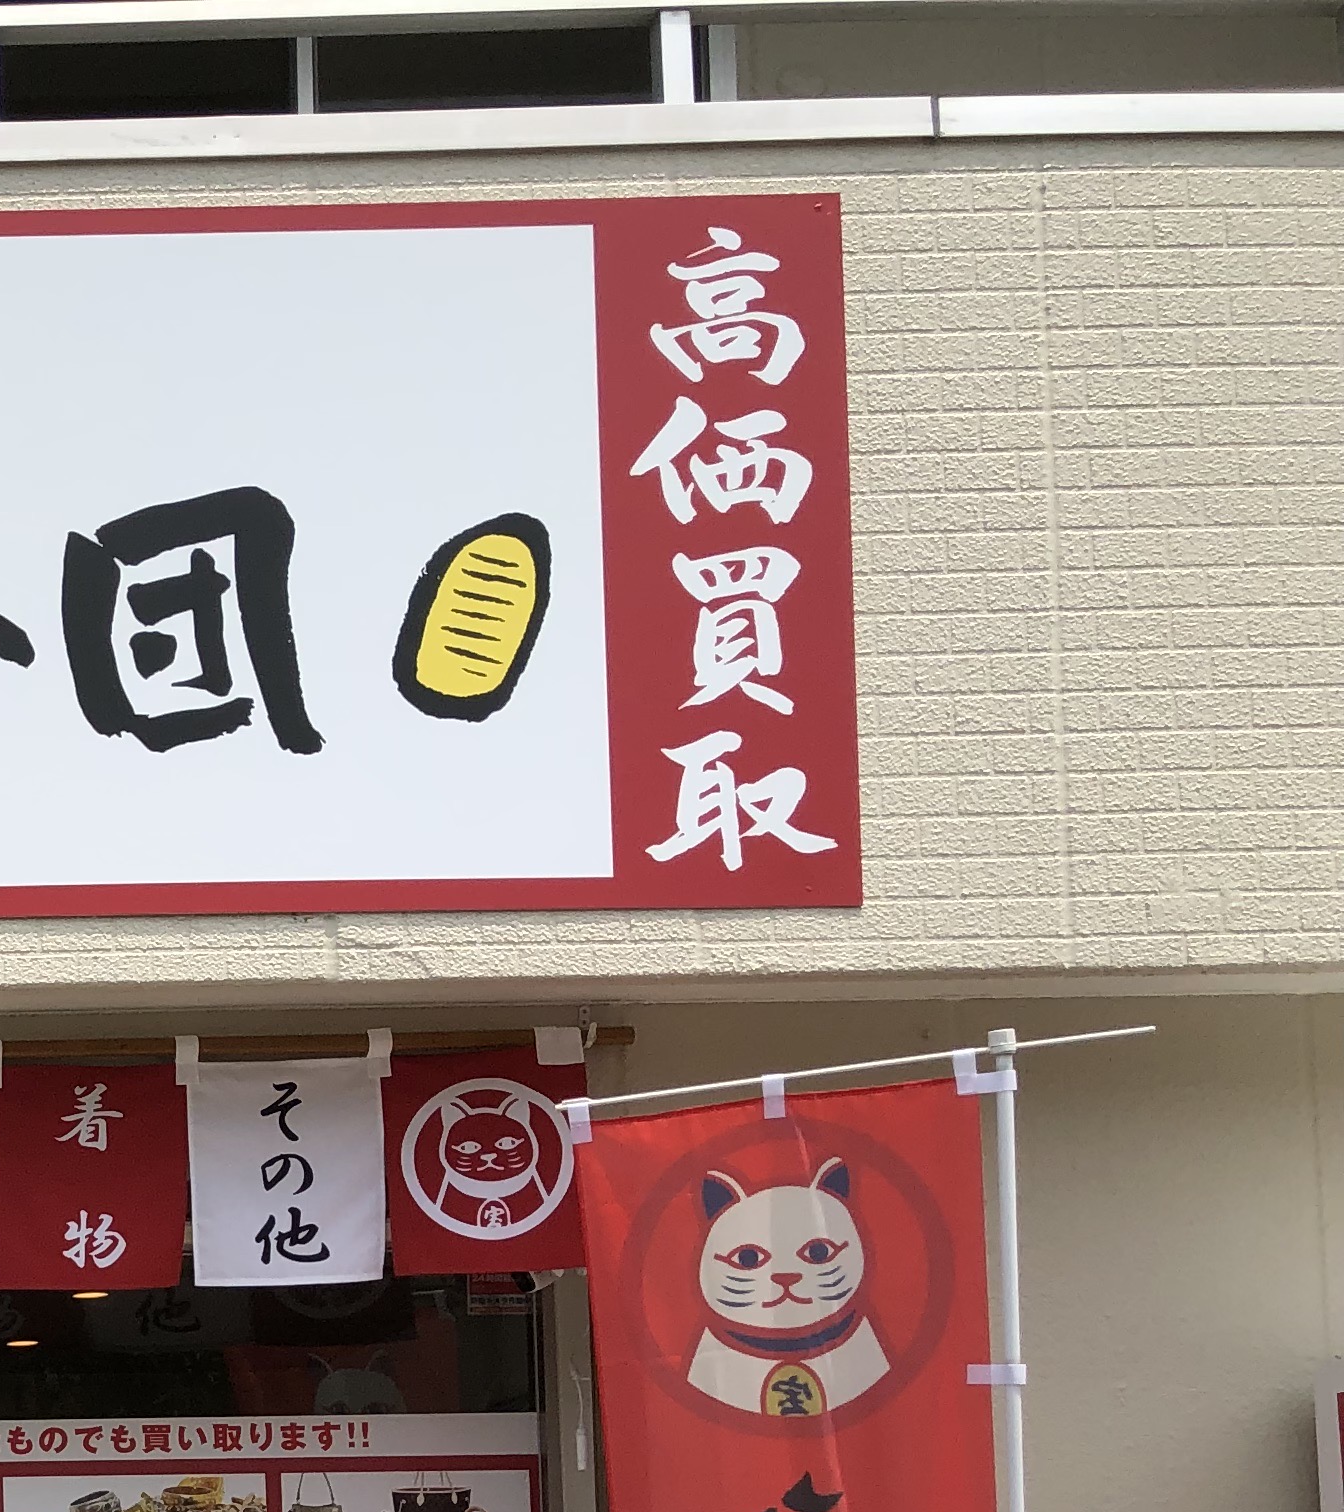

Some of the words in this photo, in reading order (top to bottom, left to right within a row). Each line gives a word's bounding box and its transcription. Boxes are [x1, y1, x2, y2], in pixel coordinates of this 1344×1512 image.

[629, 227, 838, 870] 高価買取
[54, 1084, 124, 1269] 着物
[254, 1082, 330, 1265] その他
